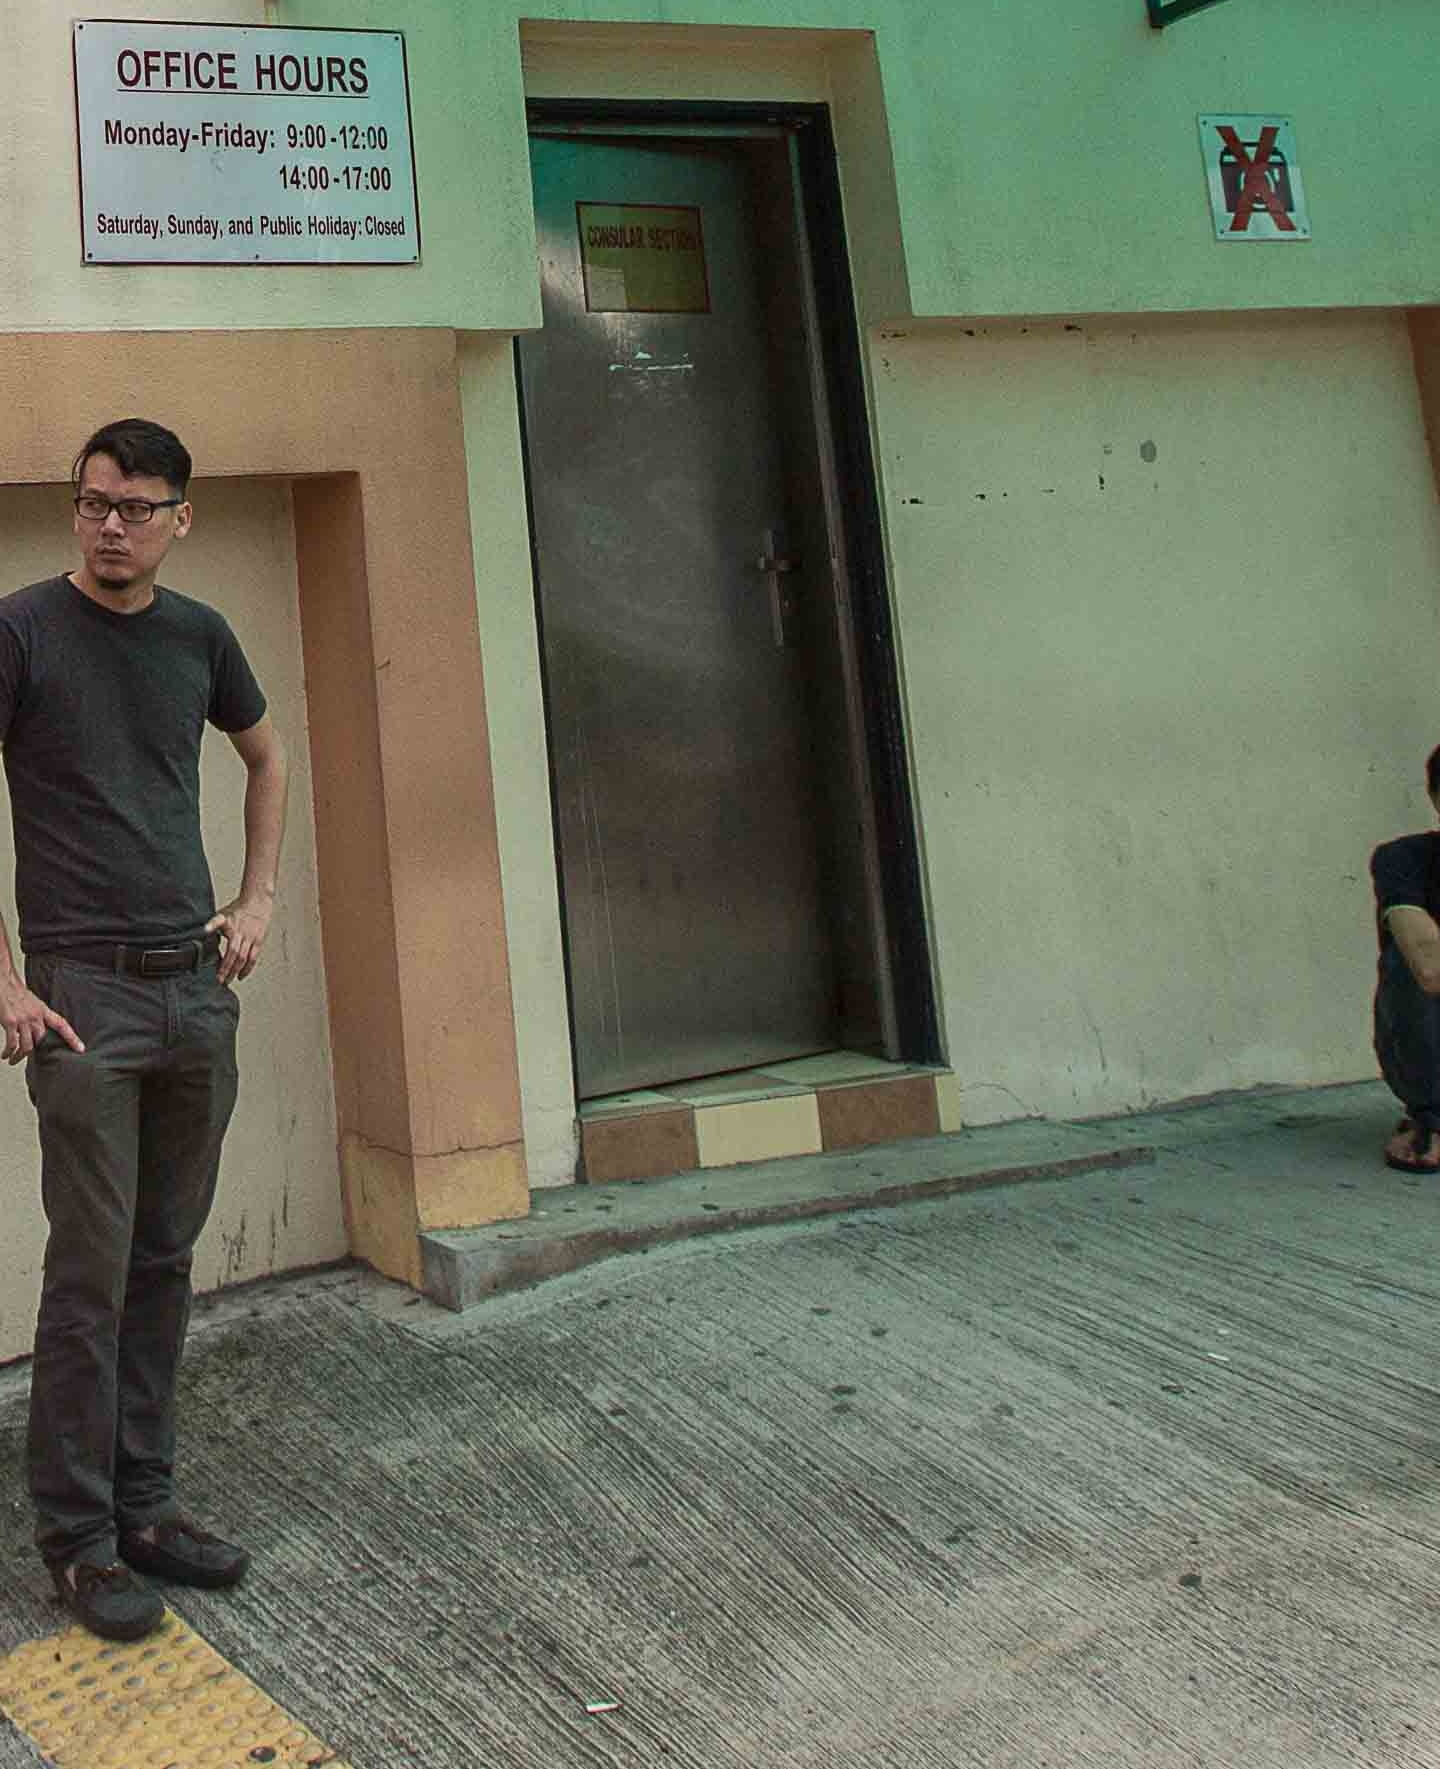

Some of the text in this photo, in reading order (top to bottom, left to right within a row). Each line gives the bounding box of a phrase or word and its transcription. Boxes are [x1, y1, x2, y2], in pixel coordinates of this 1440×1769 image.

[117, 48, 369, 94] OFFICE HOURS
[104, 119, 275, 154] Monday-Friday:
[97, 213, 406, 241] Saturday, Sunday, and Public Holiday: Closed
[587, 224, 644, 249] CONSULAR
